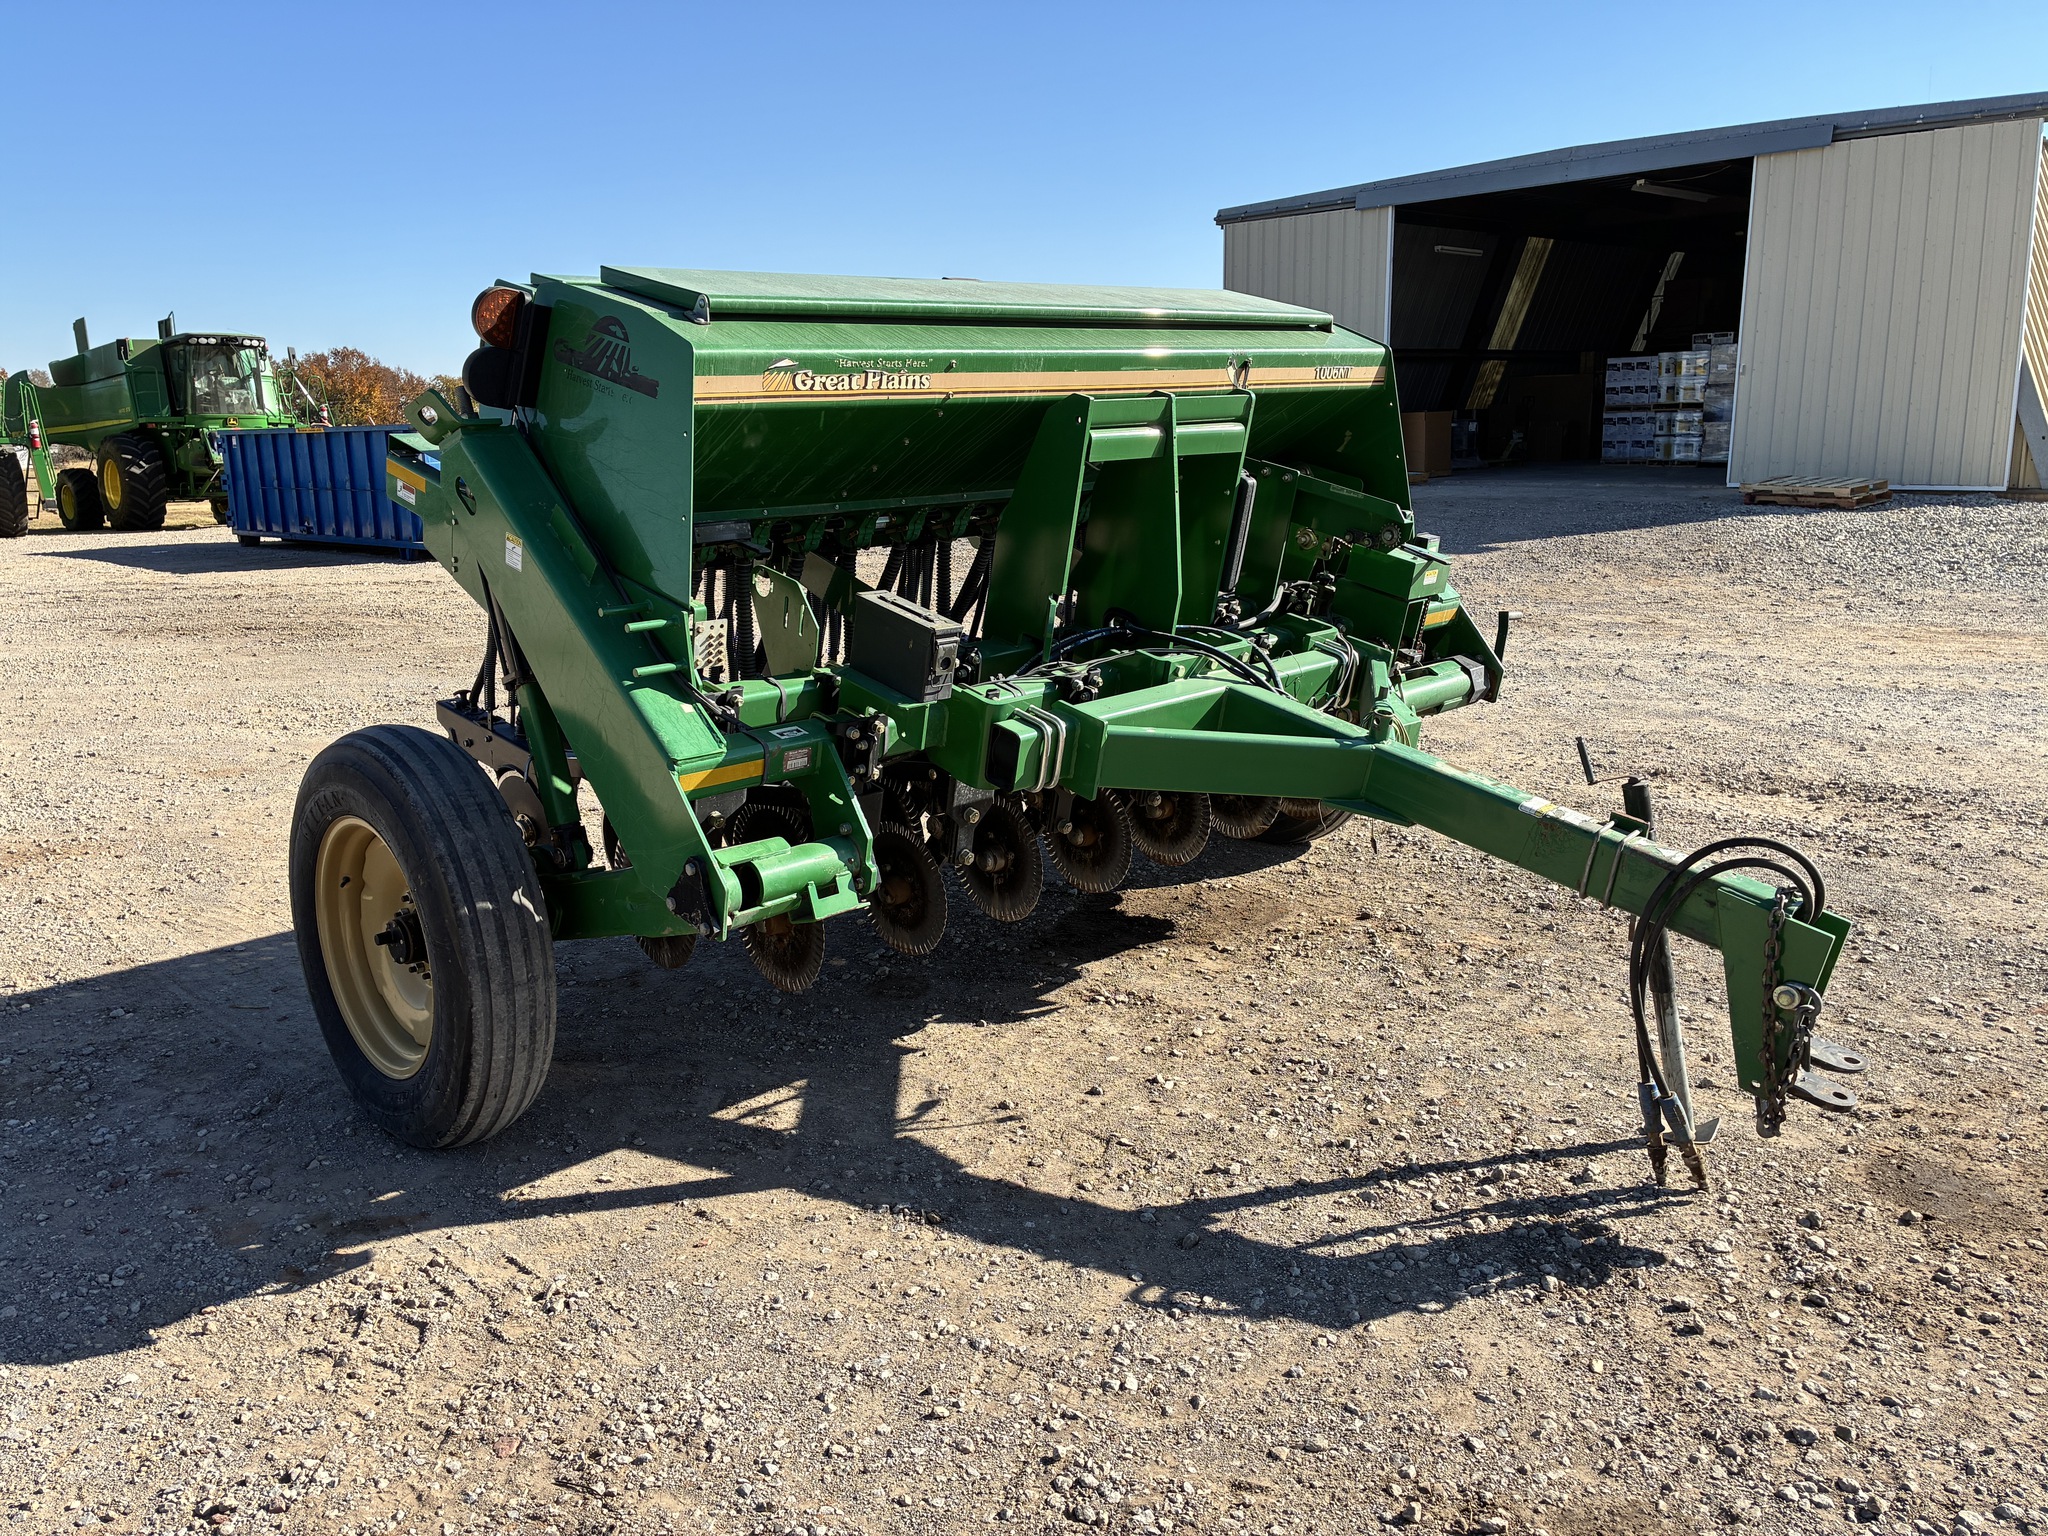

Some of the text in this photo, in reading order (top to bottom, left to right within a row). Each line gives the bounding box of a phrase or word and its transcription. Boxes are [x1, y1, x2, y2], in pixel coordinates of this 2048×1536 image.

[835, 358, 875, 368] "Harvest
[877, 357, 903, 369] Starts
[1314, 365, 1354, 380] 1006NT
[793, 370, 931, 391] Great Plains
